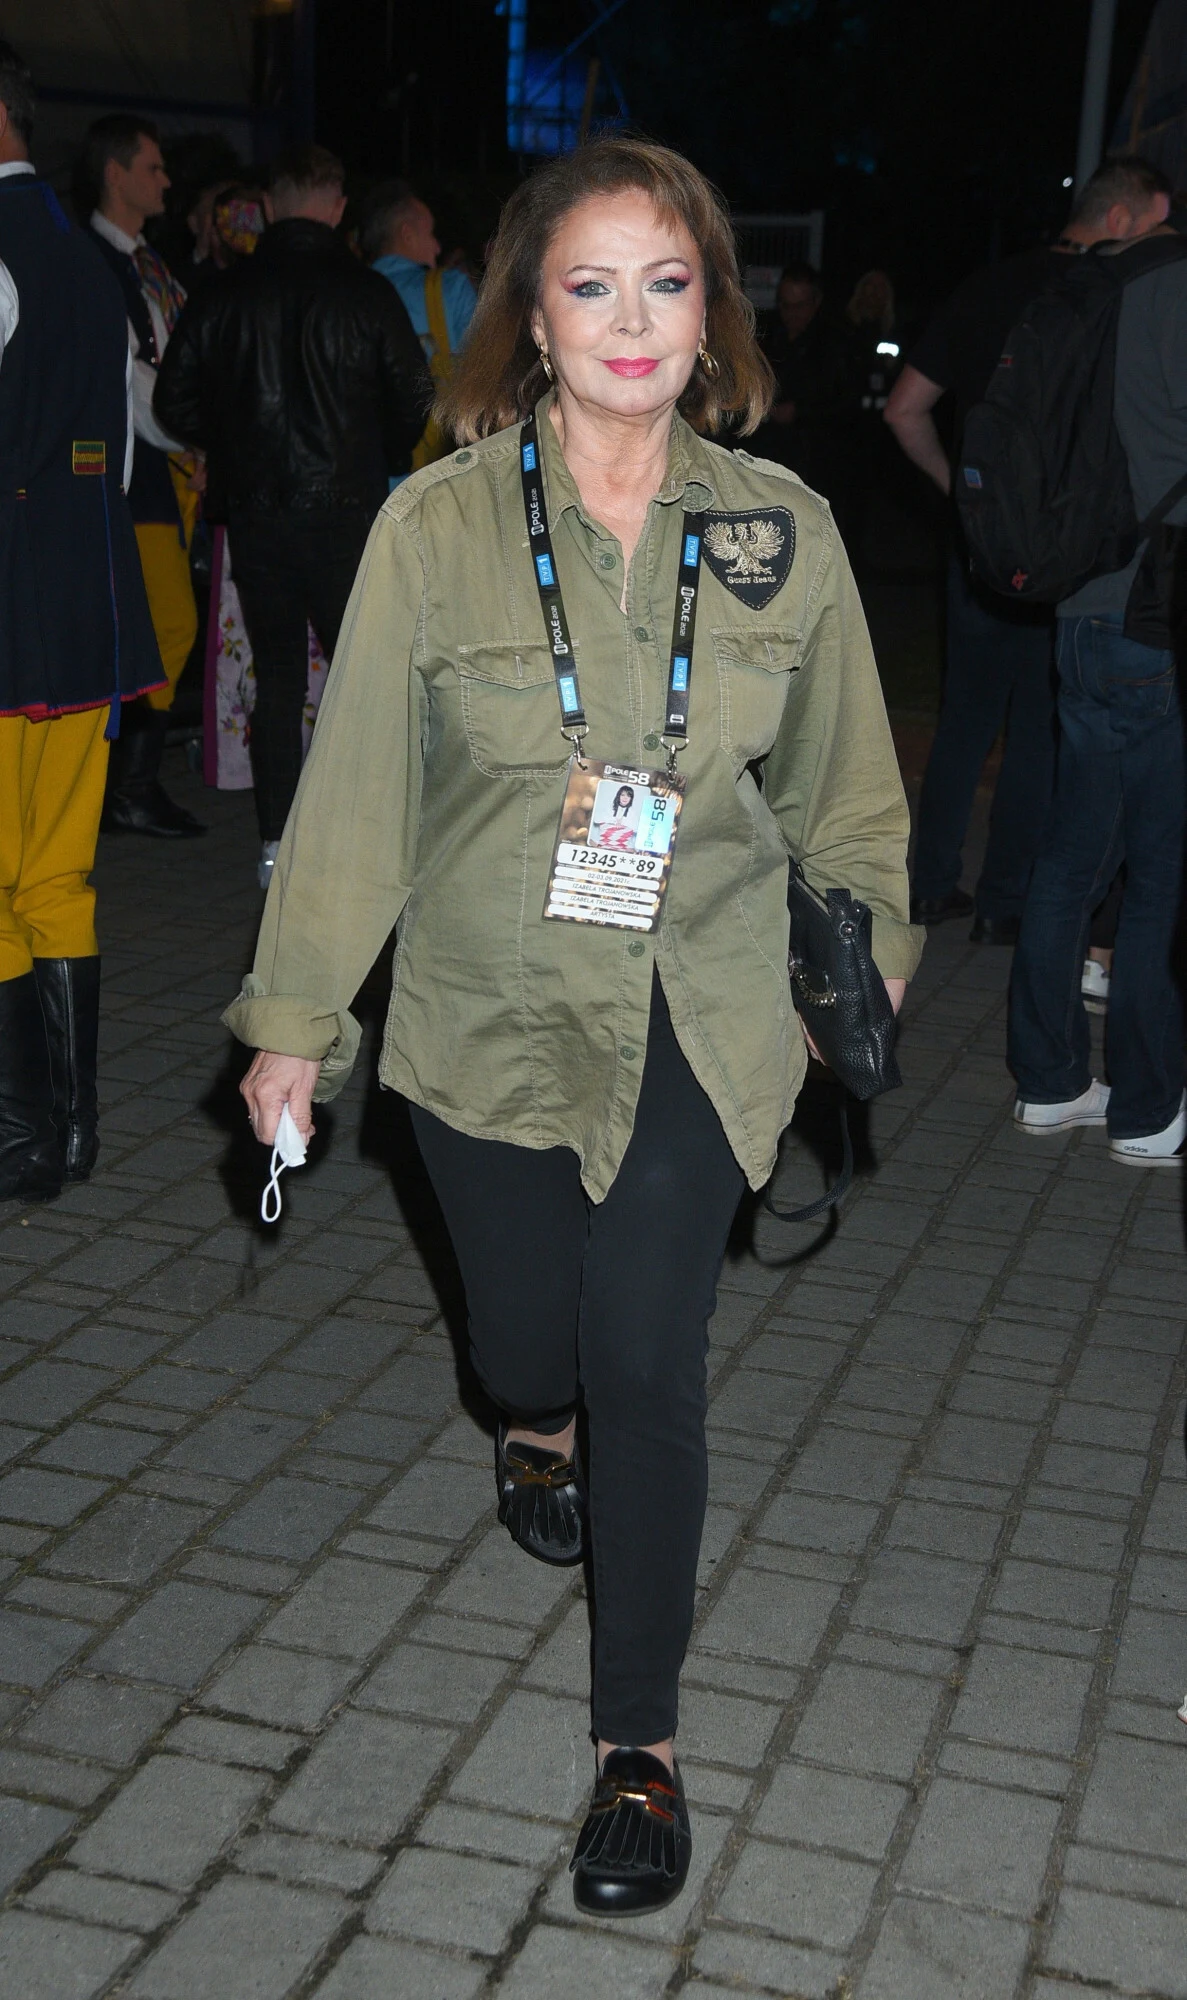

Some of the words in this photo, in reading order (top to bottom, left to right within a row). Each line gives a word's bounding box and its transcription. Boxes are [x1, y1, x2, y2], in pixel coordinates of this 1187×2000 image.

[627, 770, 651, 786] 58
[651, 798, 667, 822] 58
[572, 883, 597, 892] IZABELA
[598, 887, 641, 899] TROJANOWSKA
[570, 895, 594, 905] IZABELA
[595, 899, 639, 911] TROJANOWSKA
[590, 911, 615, 919] ARTYSTA
